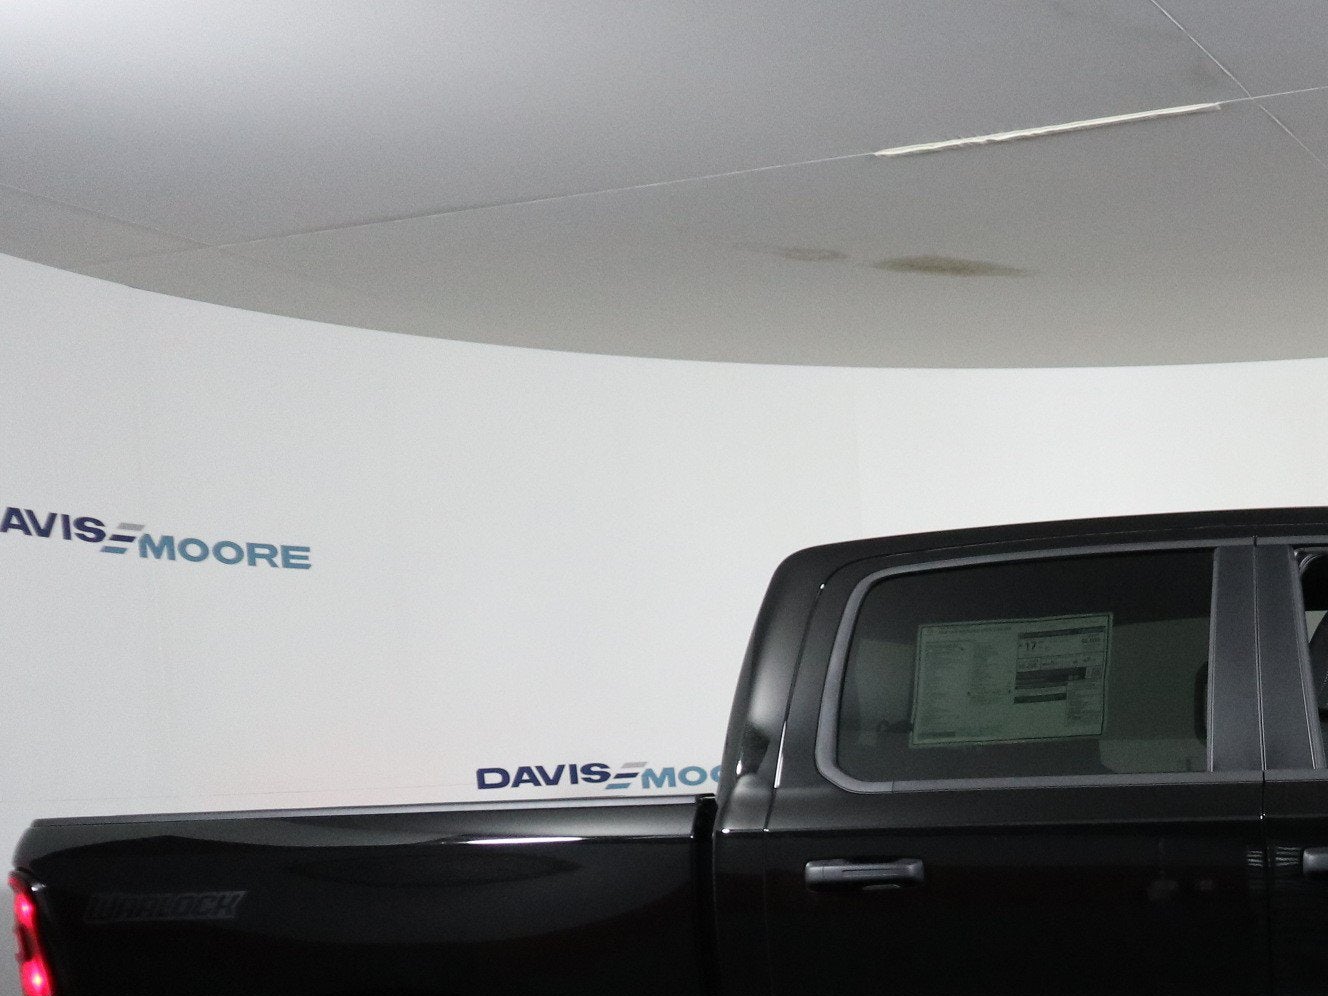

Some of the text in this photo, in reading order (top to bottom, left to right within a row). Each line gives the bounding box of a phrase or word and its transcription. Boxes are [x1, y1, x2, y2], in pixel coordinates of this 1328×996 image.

[0, 507, 312, 569] AVIS MOORE
[476, 762, 611, 790] DAVIS
